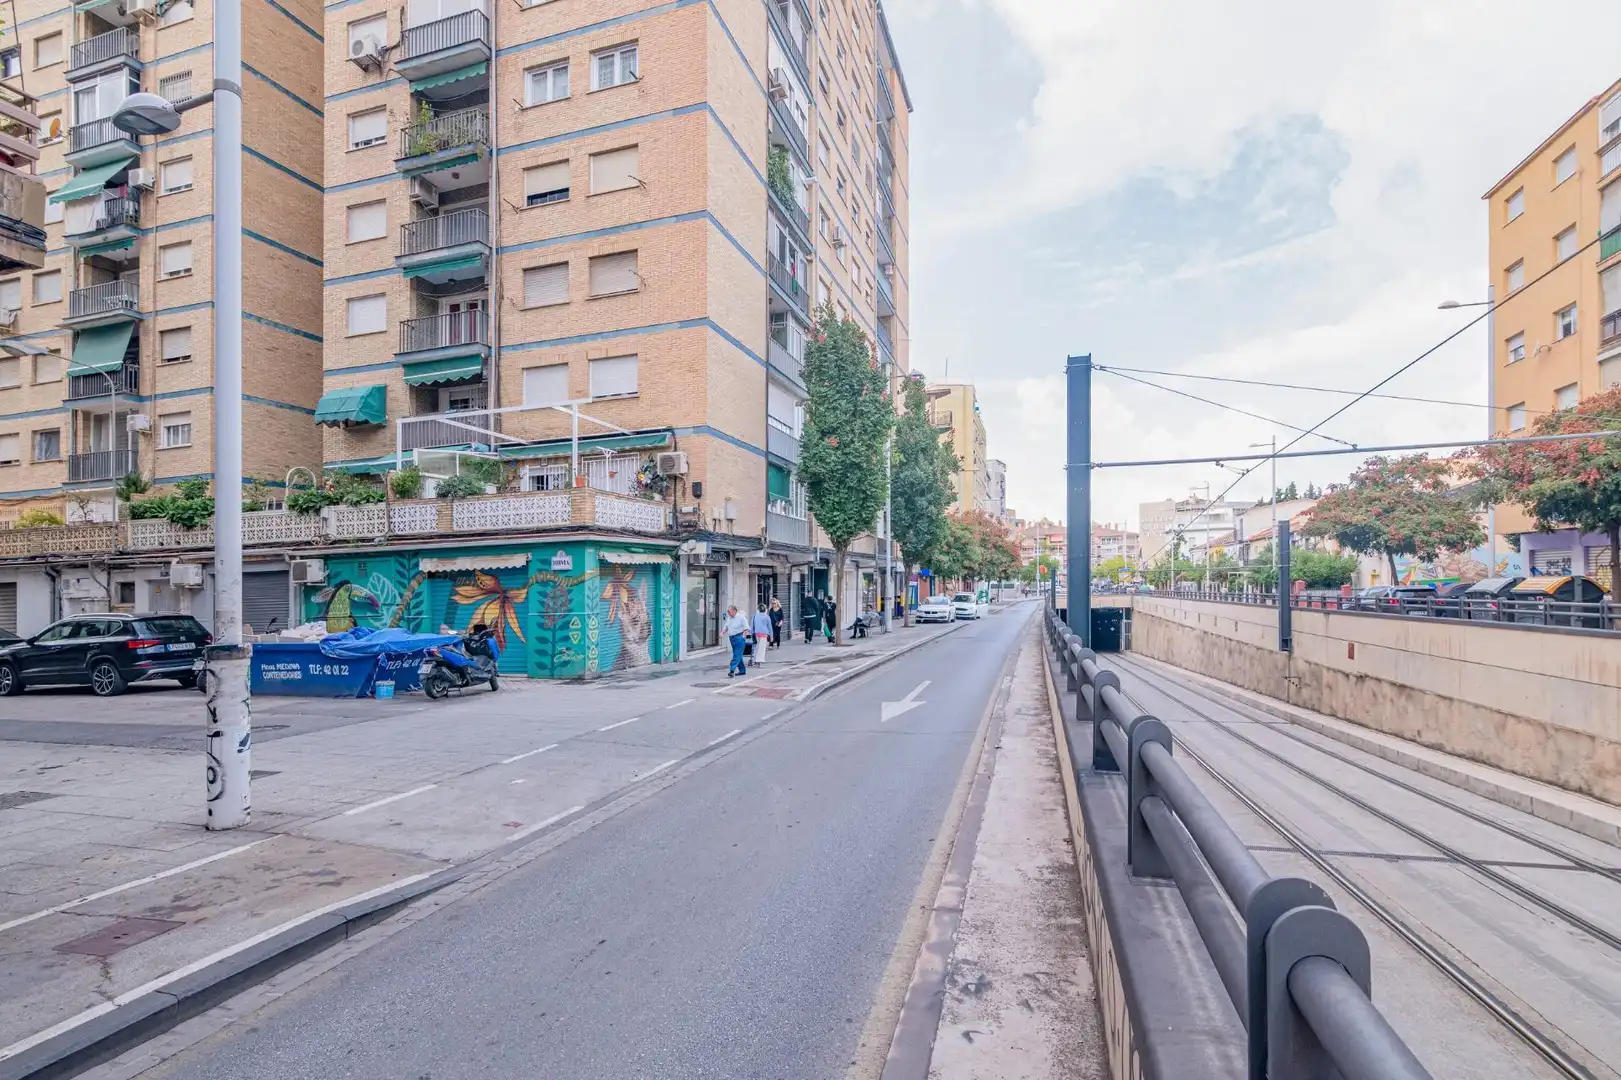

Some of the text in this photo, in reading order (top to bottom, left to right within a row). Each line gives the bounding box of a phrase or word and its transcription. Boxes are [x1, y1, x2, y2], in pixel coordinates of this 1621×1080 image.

[323, 664, 332, 675] 42
[340, 665, 350, 675] 22
[262, 671, 302, 680] CONTENEDORES
